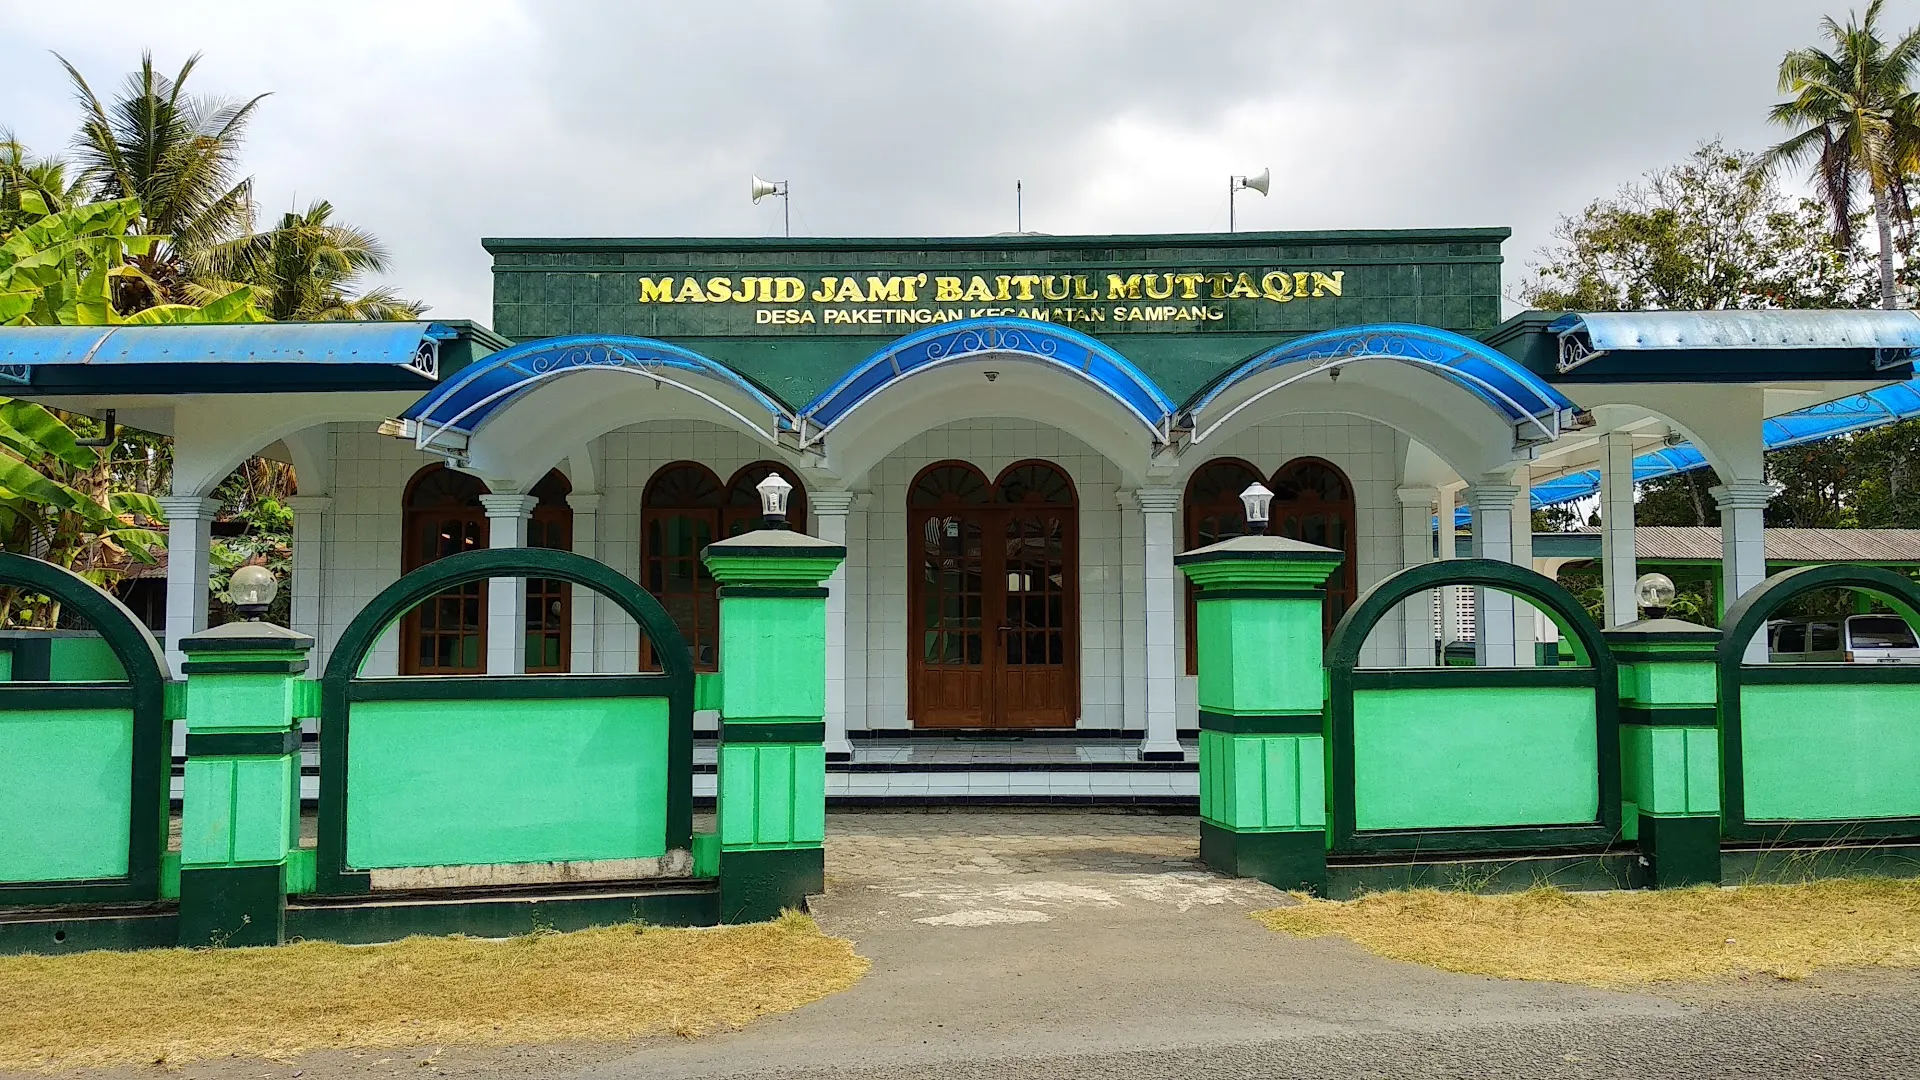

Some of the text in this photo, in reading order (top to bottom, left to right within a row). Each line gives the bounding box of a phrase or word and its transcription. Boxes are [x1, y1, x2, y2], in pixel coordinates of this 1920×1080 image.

[638, 276, 806, 303] MASJID
[934, 275, 1099, 302] BAITUL
[1106, 270, 1345, 303] MUTTAQIN
[756, 309, 817, 324] DESA
[824, 309, 963, 324] PAKETINGAN
[1112, 305, 1224, 322] SAMPANG
